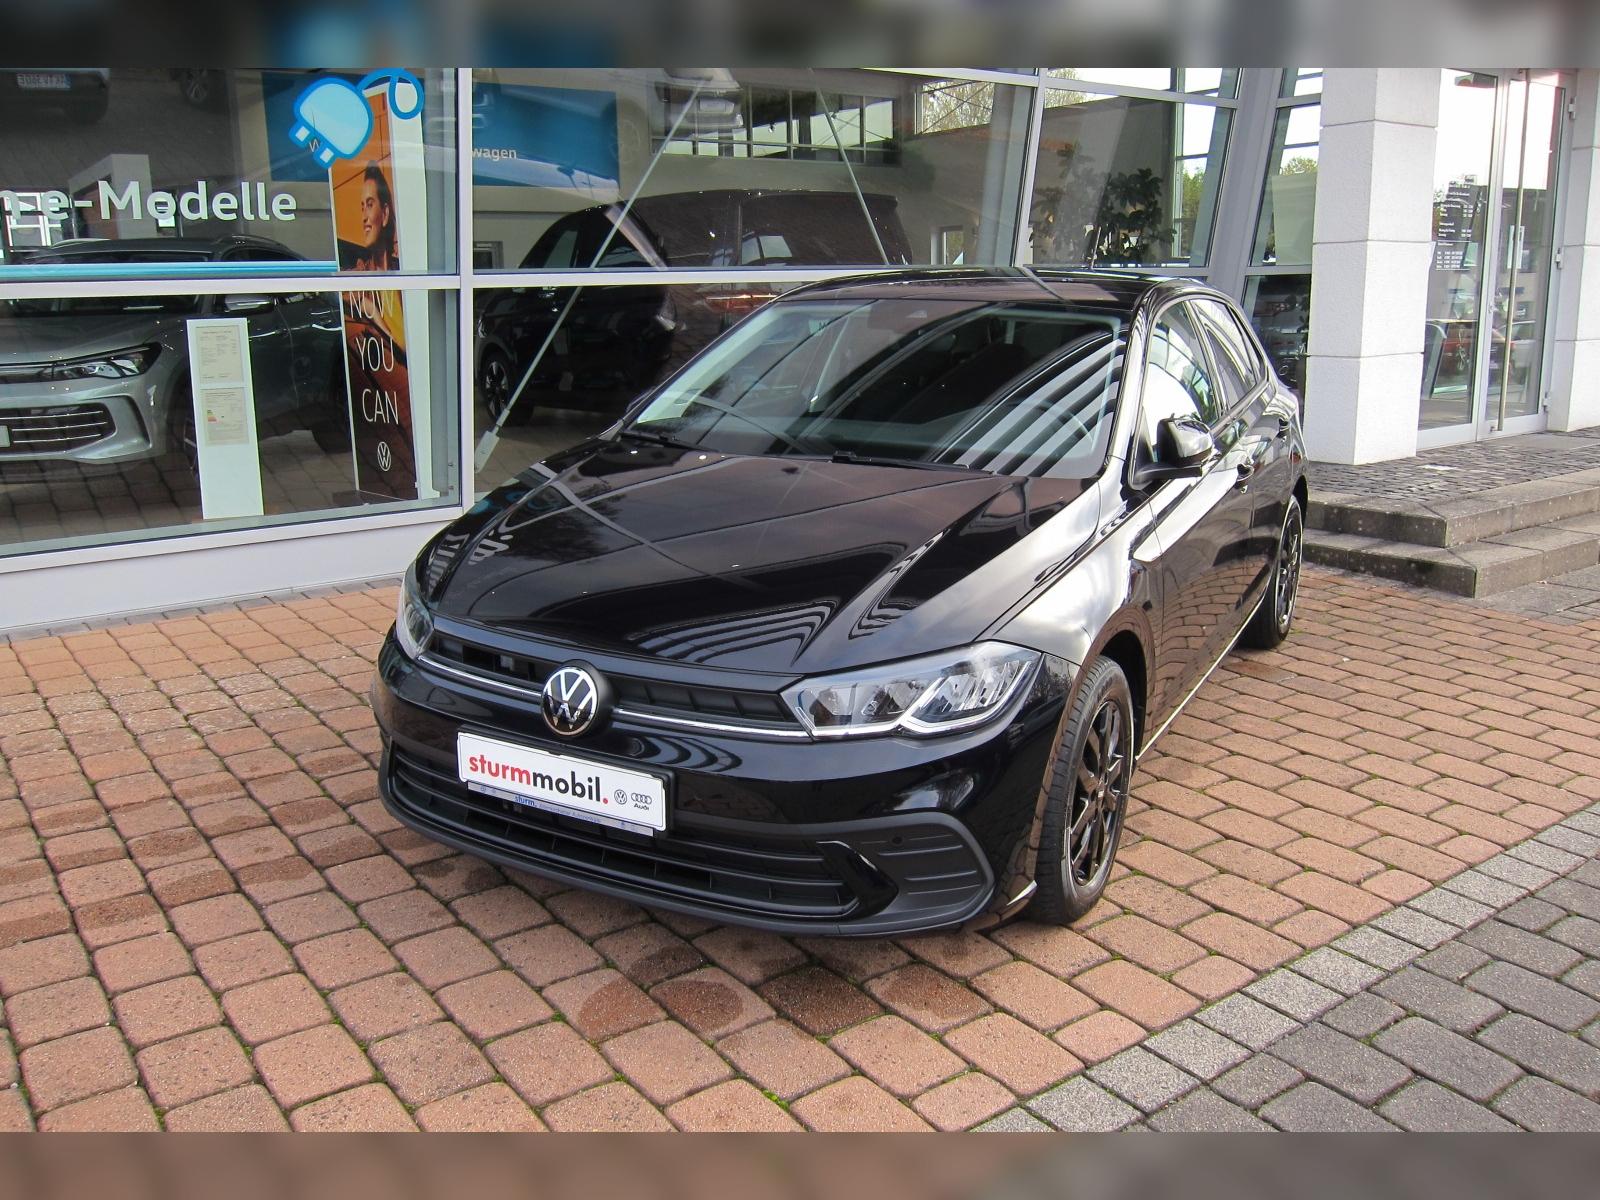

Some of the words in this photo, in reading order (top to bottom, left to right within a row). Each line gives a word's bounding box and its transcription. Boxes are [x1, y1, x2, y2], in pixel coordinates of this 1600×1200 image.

[40, 180, 297, 220] e-Modelle
[350, 290, 394, 319] NOW
[356, 336, 395, 372] YOU
[362, 388, 399, 425] CAN
[469, 754, 608, 804] sturmmobil.
[633, 803, 650, 811] Audi
